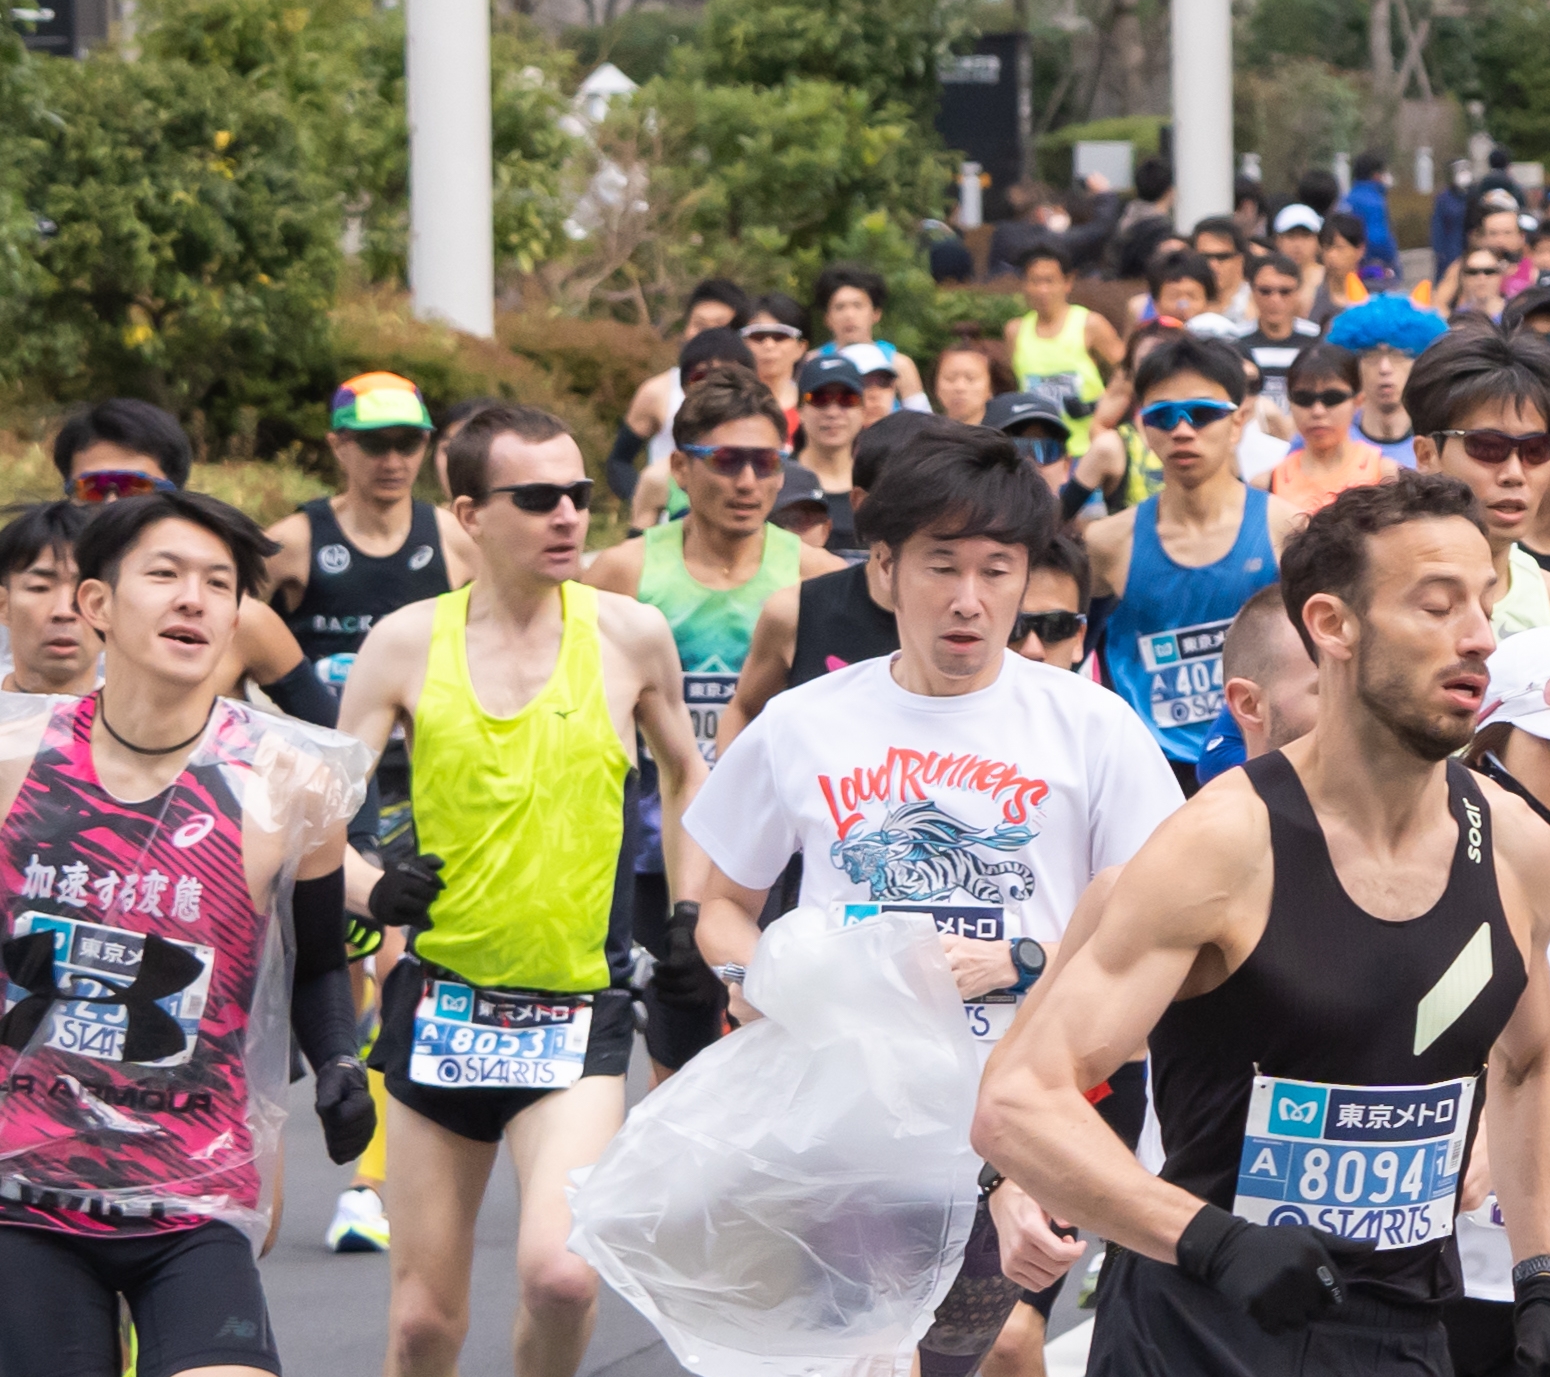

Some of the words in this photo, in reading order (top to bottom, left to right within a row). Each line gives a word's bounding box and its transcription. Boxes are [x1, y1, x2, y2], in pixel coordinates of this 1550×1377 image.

[1181, 630, 1226, 655] 東京メ
[689, 681, 736, 698] 東京メ
[1462, 797, 1482, 864] soar
[20, 855, 206, 922] 加速する変態
[939, 917, 998, 939] メトロ
[81, 942, 143, 965] 東京メ
[1337, 1097, 1456, 1130] 東京メトロ
[1251, 1149, 1278, 1176] A
[1299, 1148, 1425, 1204] 8094
